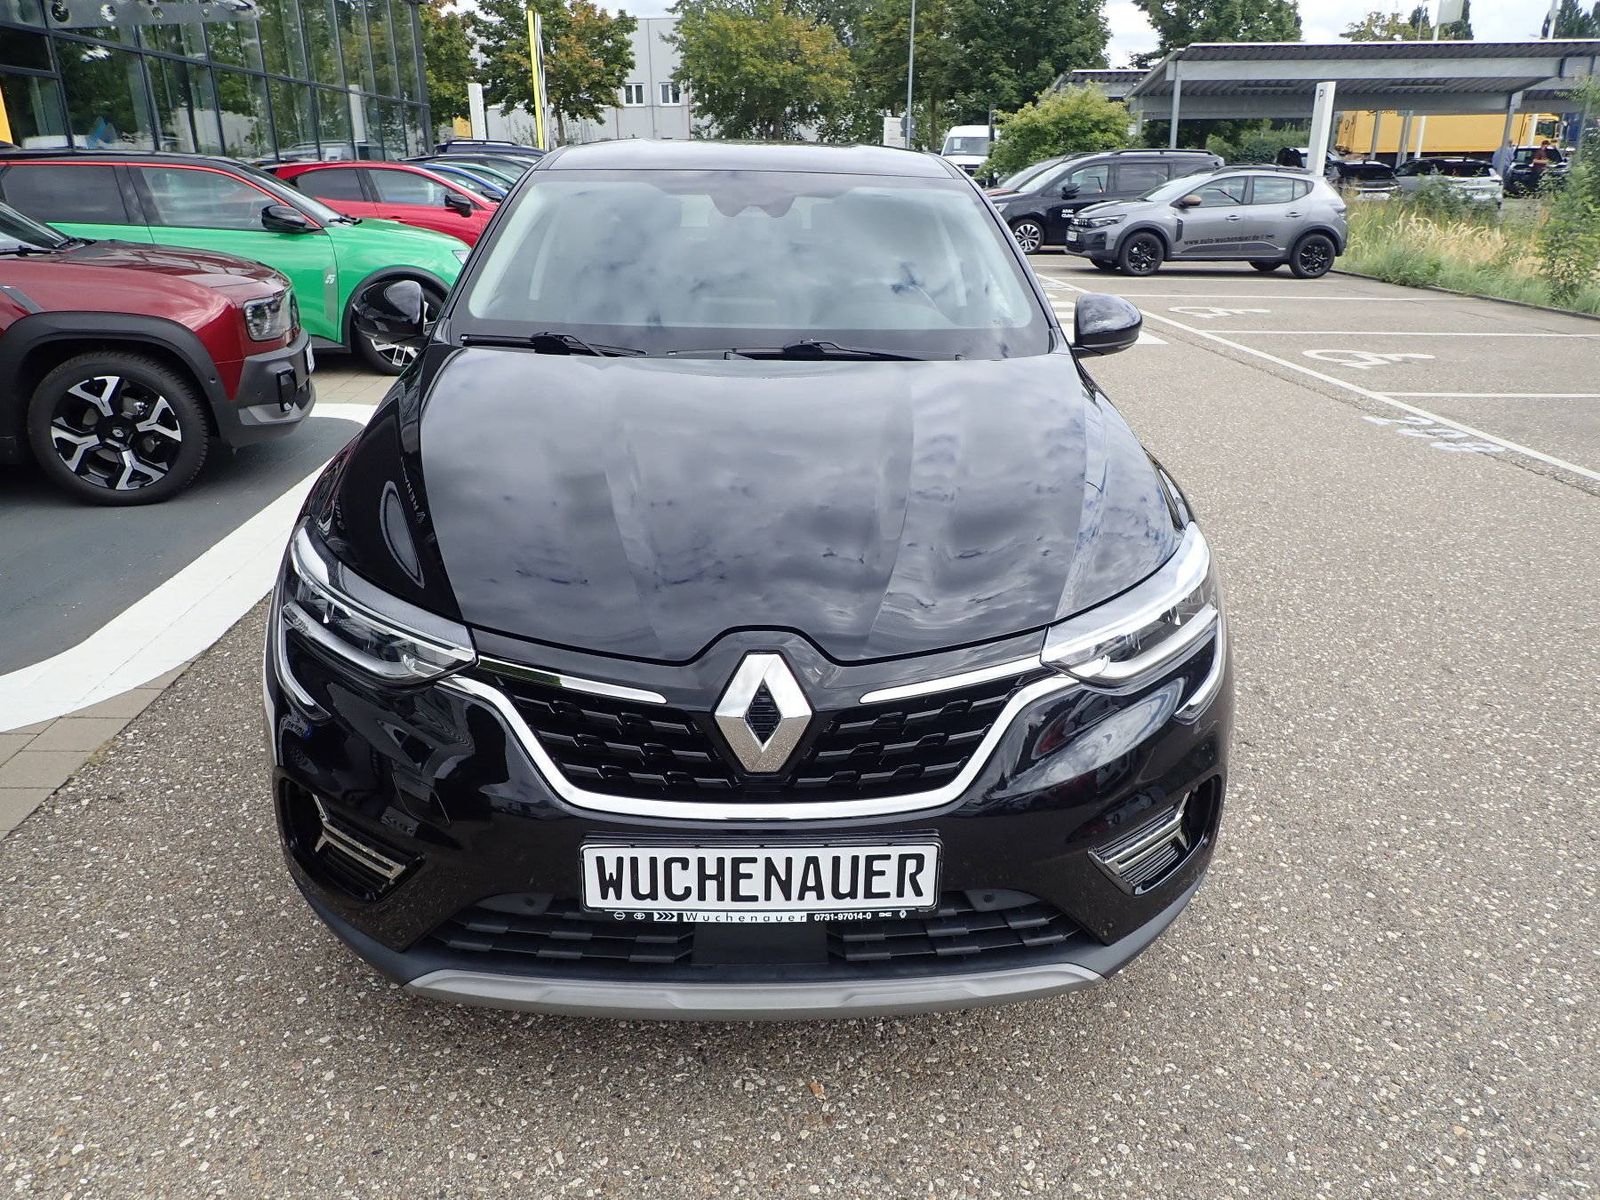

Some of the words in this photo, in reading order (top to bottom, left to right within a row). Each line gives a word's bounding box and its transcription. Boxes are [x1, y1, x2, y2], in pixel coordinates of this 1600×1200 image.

[1318, 89, 1325, 102] P
[595, 852, 926, 902] WUCHENAUER
[685, 911, 806, 923] Wuchenauer
[813, 911, 872, 921] 0731-97014-0
